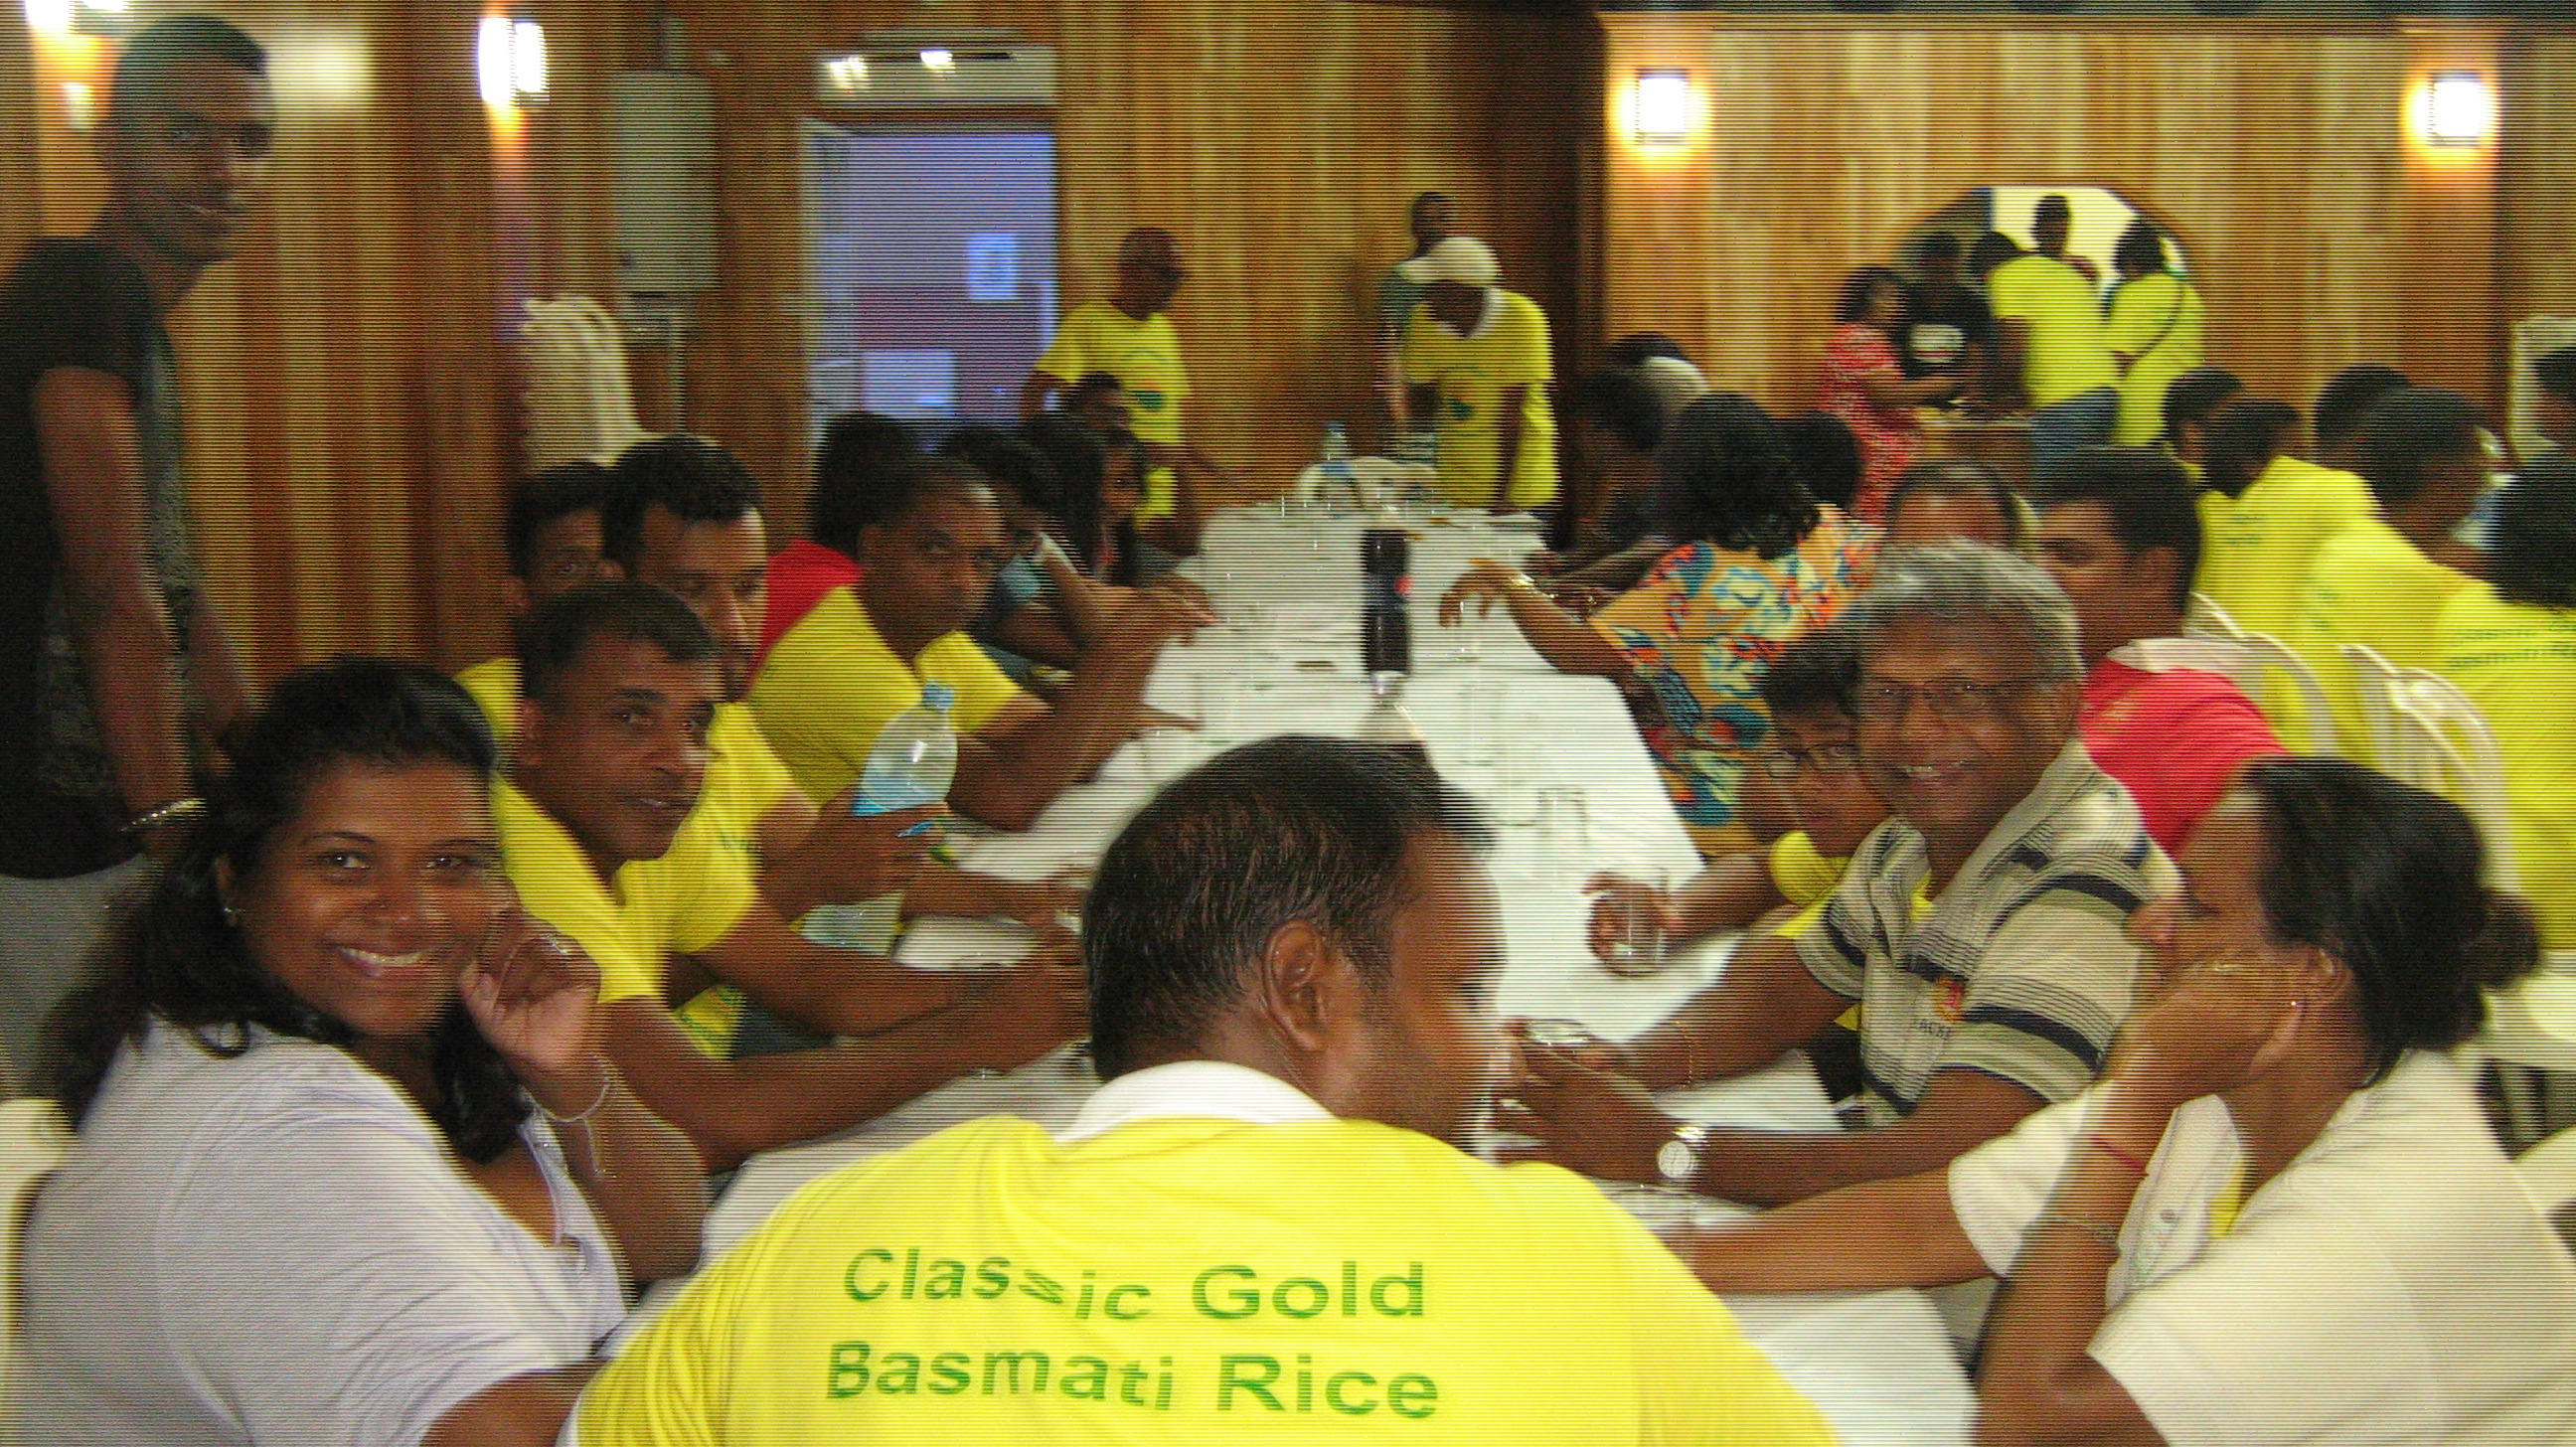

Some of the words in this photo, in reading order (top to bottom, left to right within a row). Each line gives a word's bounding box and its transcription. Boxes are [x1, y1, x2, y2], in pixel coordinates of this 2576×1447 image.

[845, 1247, 1153, 1320] Classic
[1193, 1261, 1424, 1320] Gold
[827, 1340, 1174, 1411] Basmati
[1217, 1354, 1439, 1419] Rice
